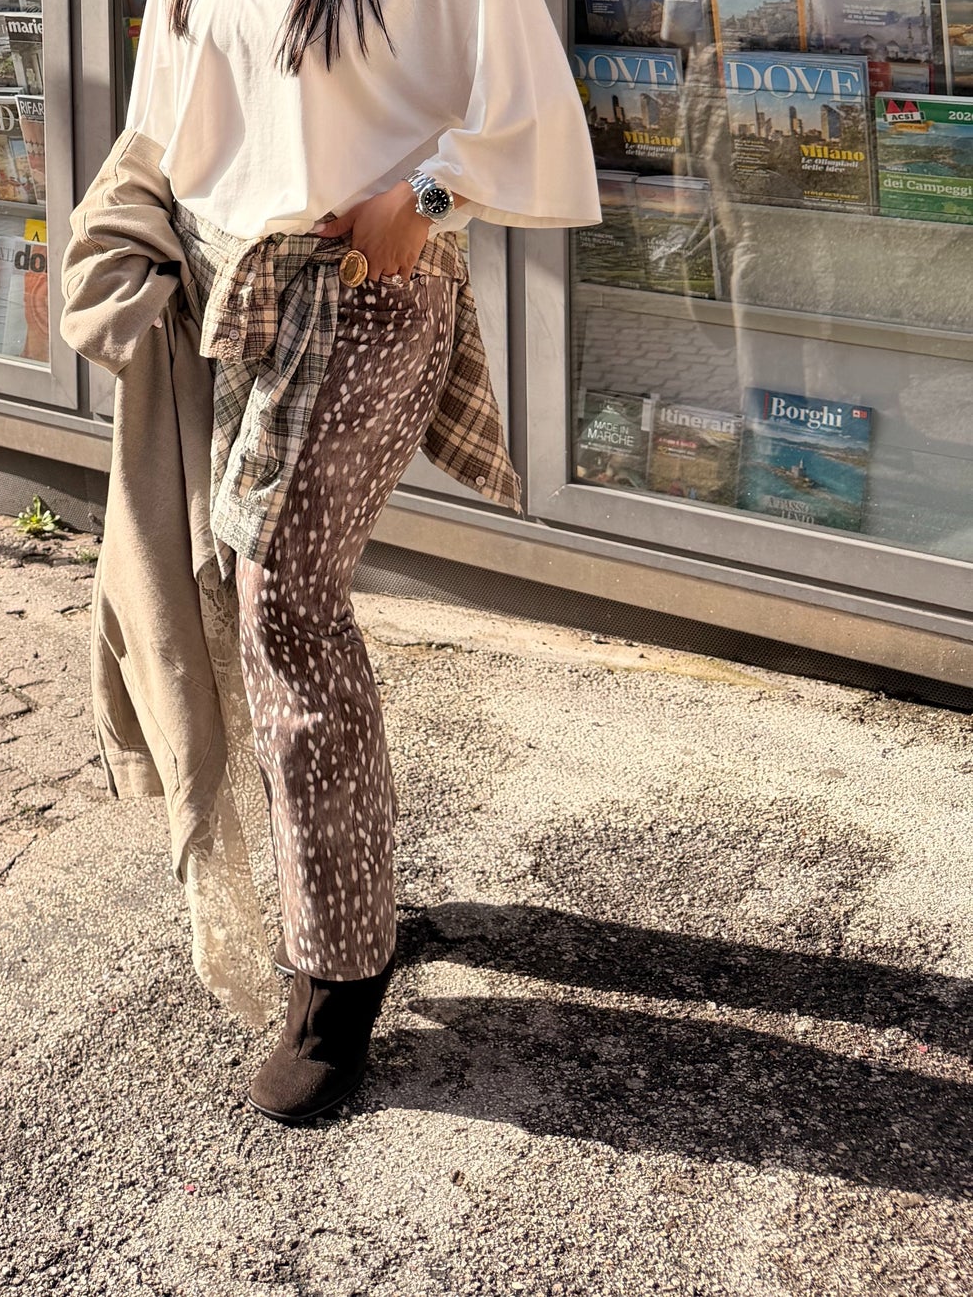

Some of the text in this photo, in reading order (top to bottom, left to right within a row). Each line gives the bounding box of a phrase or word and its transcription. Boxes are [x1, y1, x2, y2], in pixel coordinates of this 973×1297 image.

[726, 61, 862, 103] DOVE
[891, 112, 915, 121] ACSI
[623, 130, 682, 147] Milano
[637, 144, 679, 153] Olimpiadi
[646, 149, 667, 158] idee
[800, 144, 865, 162] Milano
[801, 156, 859, 168] Le Olimpiadi
[801, 163, 846, 173] delle idee
[883, 179, 973, 197] dei Campeggi
[660, 407, 735, 435] Itinerari
[770, 396, 843, 430] Borghi
[594, 420, 630, 435] MADE IN
[586, 428, 635, 447] MARCHE
